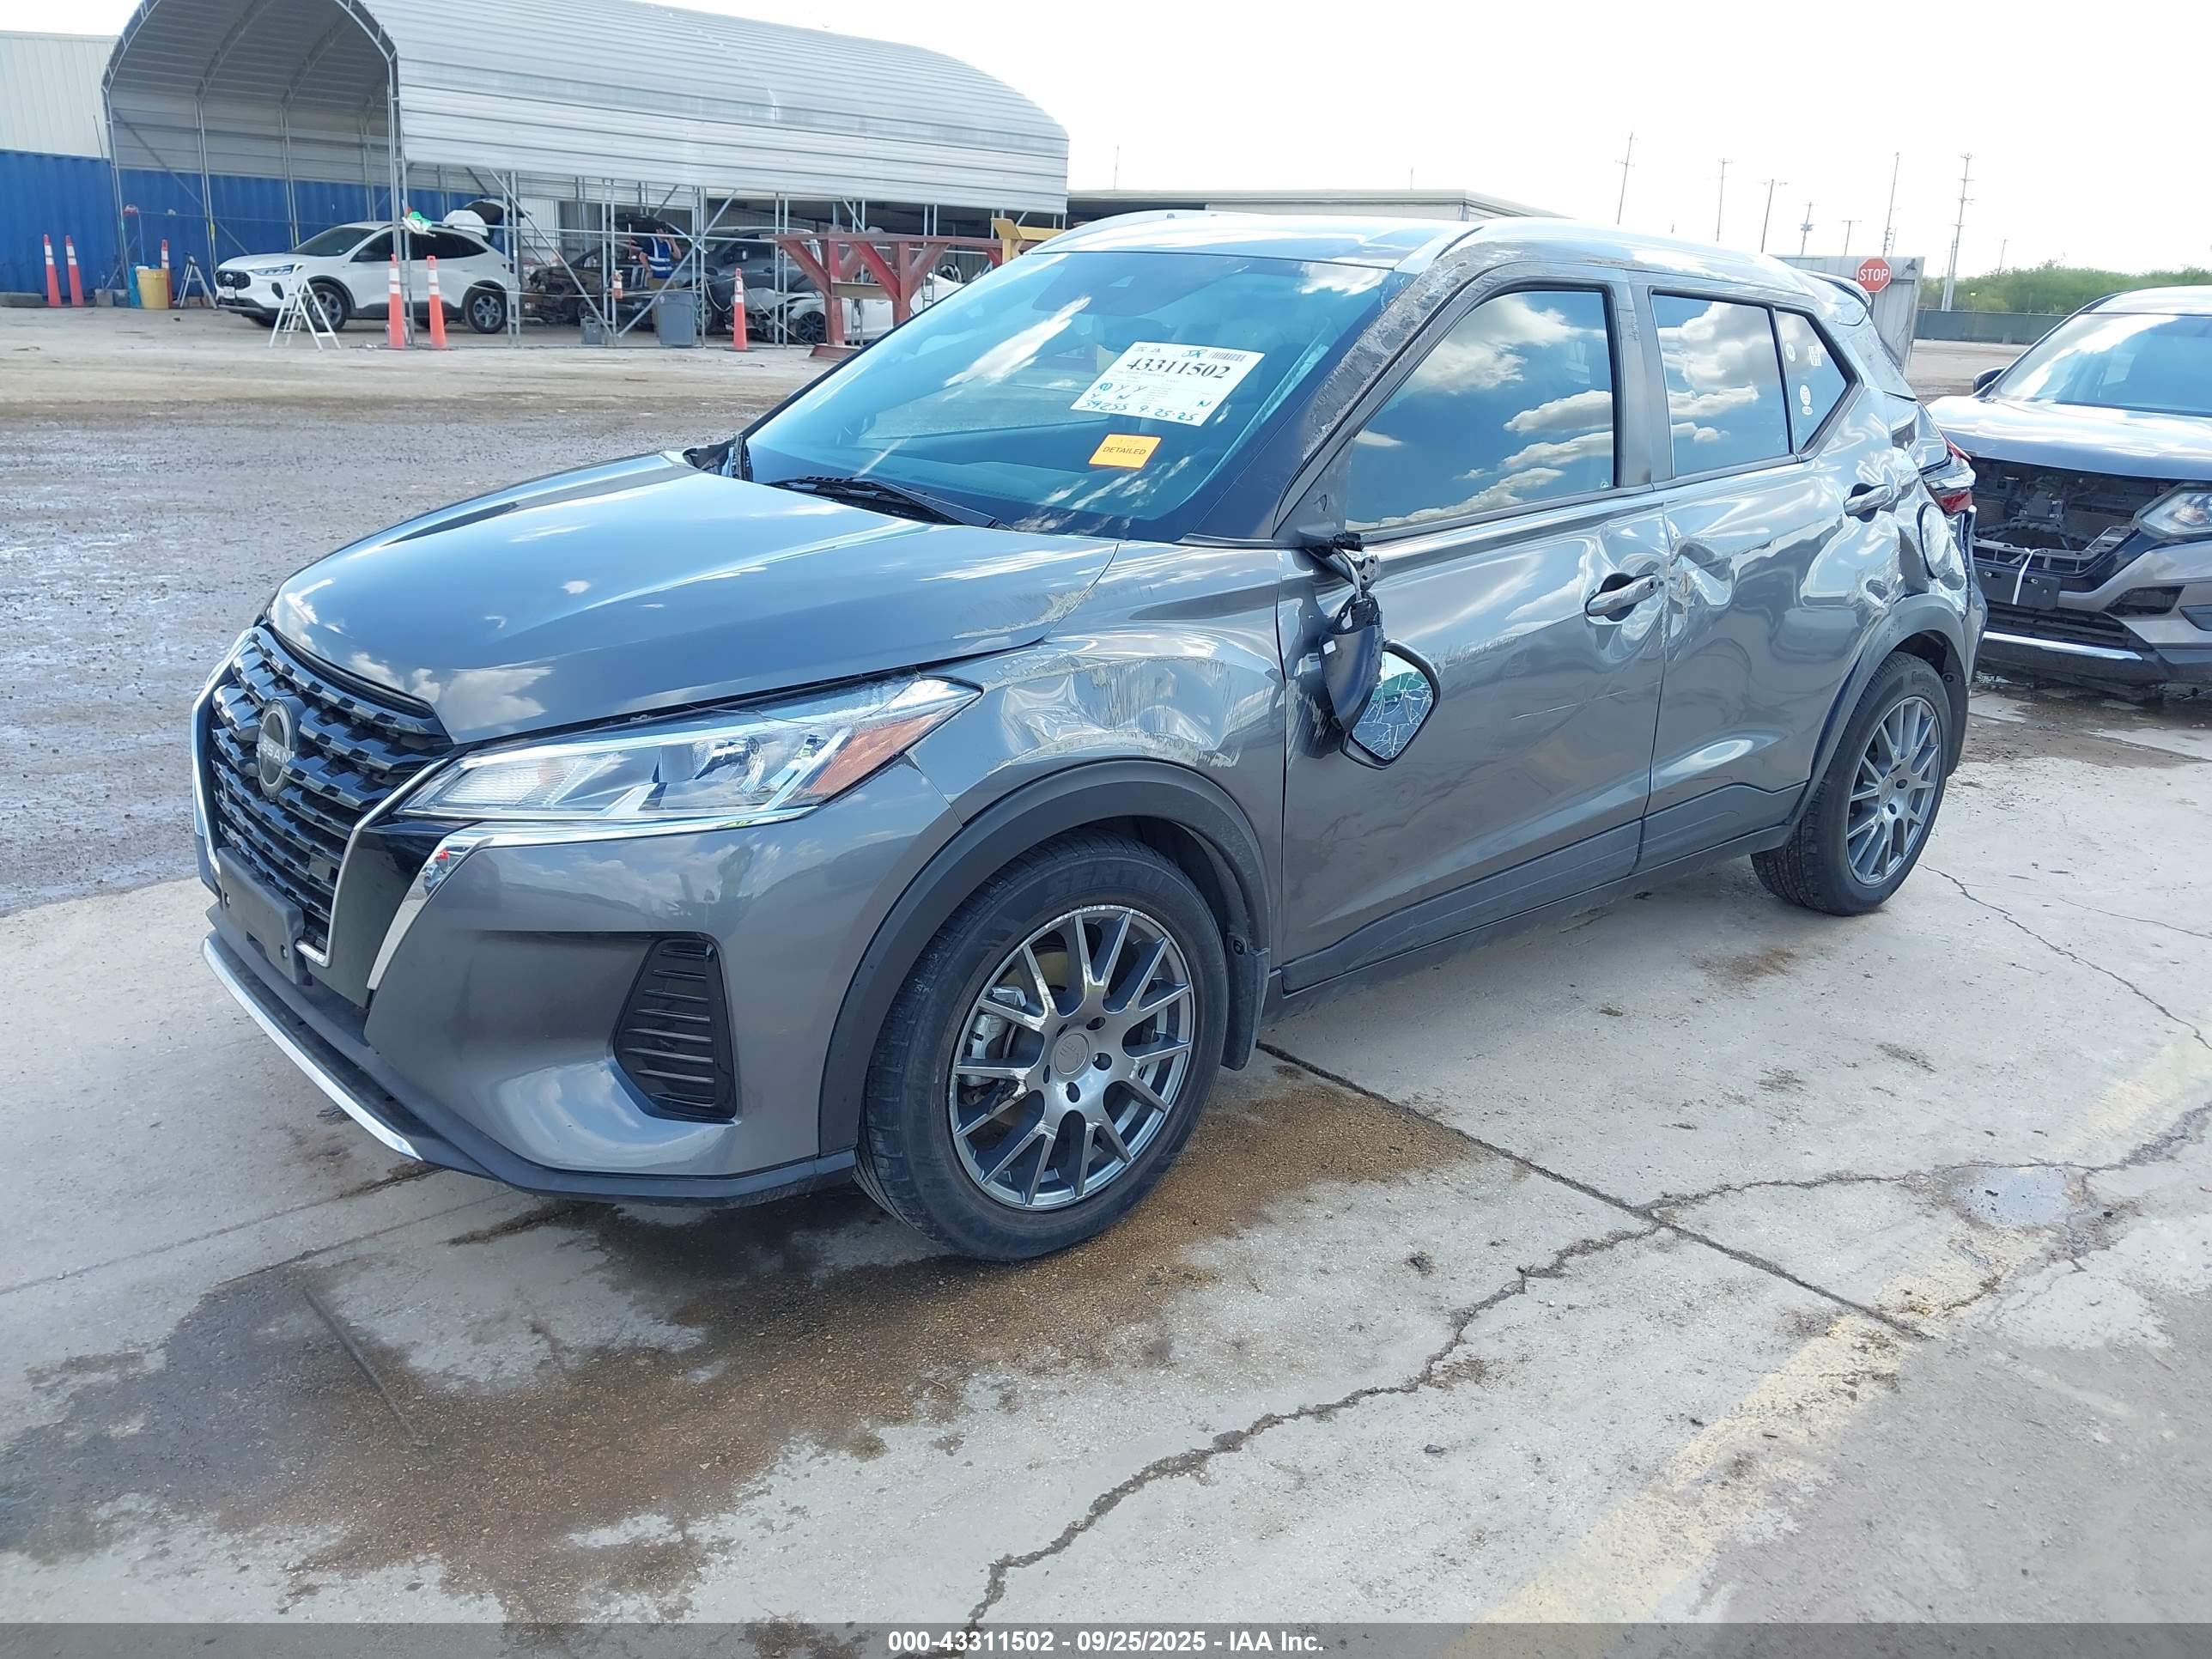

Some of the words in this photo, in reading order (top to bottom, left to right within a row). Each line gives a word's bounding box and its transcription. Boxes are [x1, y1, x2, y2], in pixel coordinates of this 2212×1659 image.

[1859, 268, 1889, 282] STOP
[1127, 357, 1231, 380] 43311502
[1103, 446, 1146, 456] DETAILED
